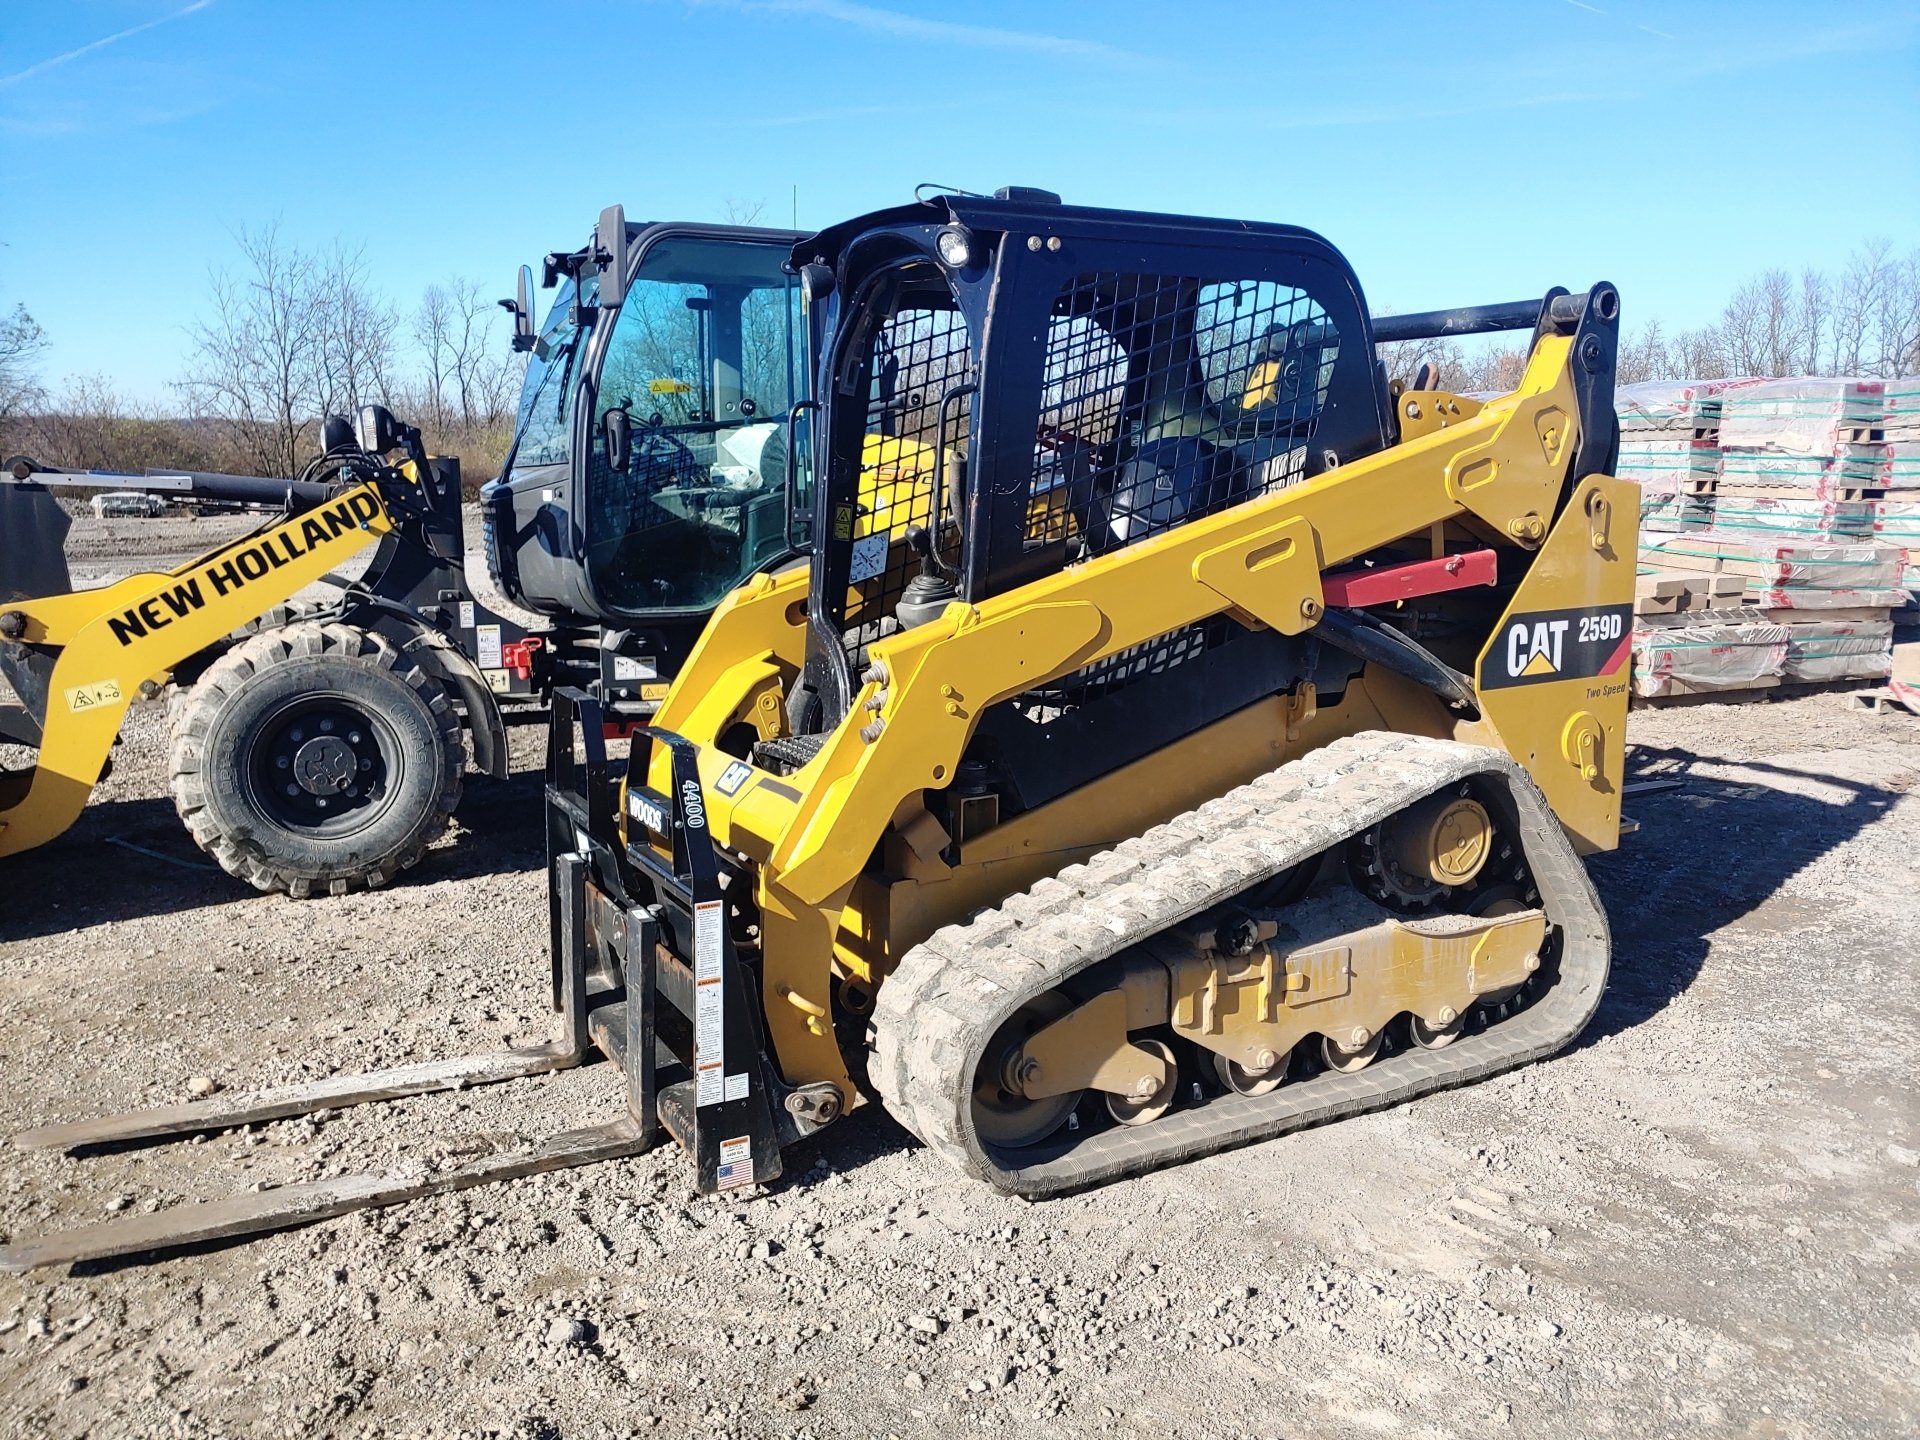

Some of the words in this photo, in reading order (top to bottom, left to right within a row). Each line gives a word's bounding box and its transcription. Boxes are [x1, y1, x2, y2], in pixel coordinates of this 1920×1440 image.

[107, 578, 205, 646] NEW
[206, 492, 379, 596] HOLLAND
[1507, 620, 1569, 677] CAT
[1578, 614, 1622, 643] 259D
[1586, 687, 1601, 700] Two
[1602, 682, 1626, 698] Speed
[717, 762, 752, 794] CAT
[629, 794, 662, 833] WOODS
[682, 780, 705, 829] 4400
